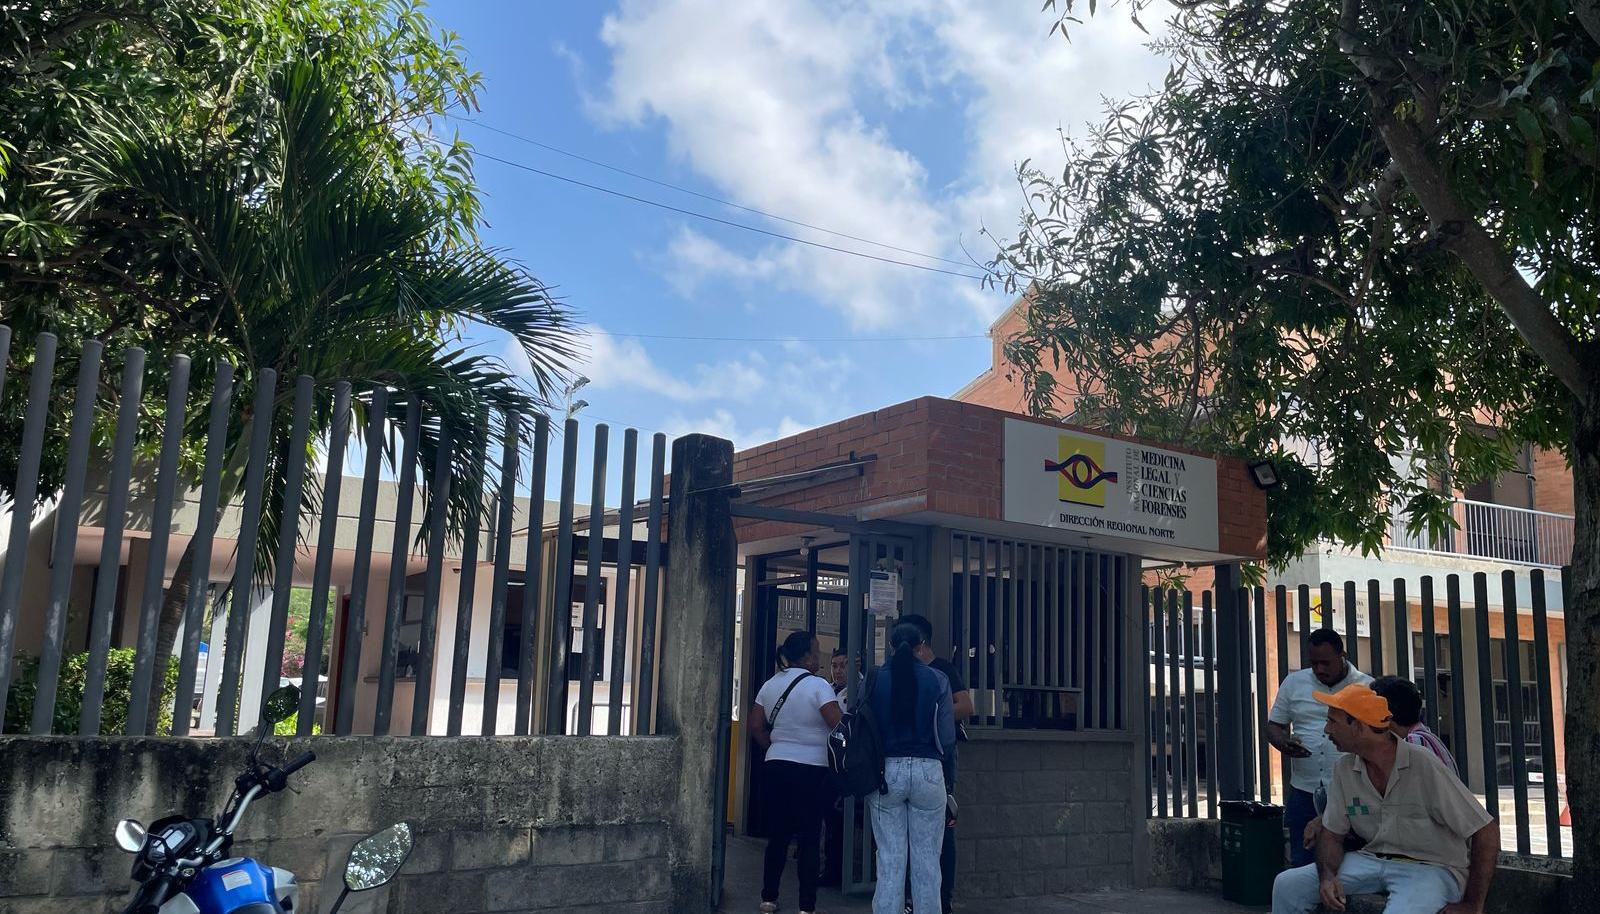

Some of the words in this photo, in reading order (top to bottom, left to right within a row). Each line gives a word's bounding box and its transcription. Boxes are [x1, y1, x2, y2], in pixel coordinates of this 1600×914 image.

[1141, 450, 1186, 471] MEDICINA
[1141, 466, 1171, 484] LEGAL
[1174, 472, 1180, 485] Y
[1141, 483, 1187, 503] CIENCIAS
[1141, 499, 1187, 519] FORENSES
[1059, 513, 1105, 528] DIRECCIÓN
[1106, 520, 1147, 535] REGIONAL
[1148, 526, 1175, 540] NORTE
